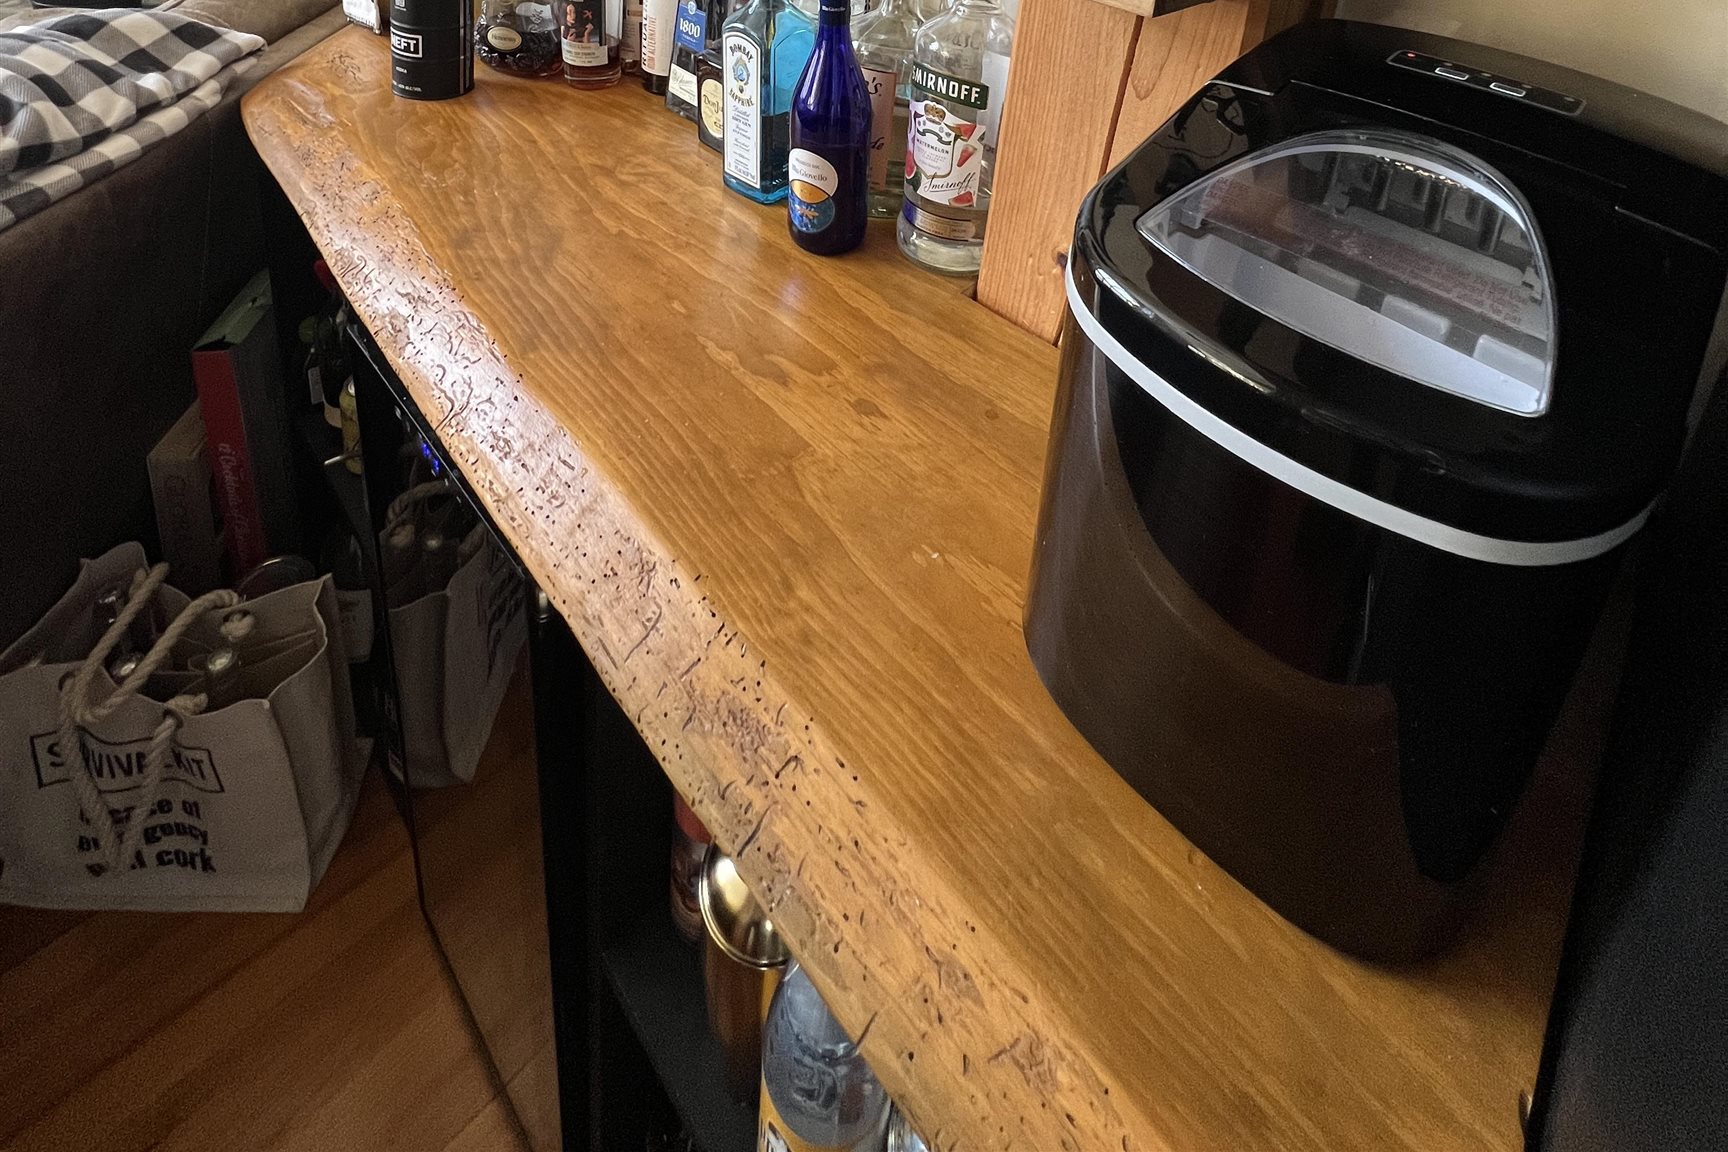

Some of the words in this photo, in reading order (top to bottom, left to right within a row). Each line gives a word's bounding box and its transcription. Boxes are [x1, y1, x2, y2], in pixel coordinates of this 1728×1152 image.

[679, 17, 701, 38] 1800
[729, 43, 754, 62] BOMBAY
[729, 88, 755, 107] SAPPHIRE
[916, 138, 950, 155] WATERMELON
[924, 171, 976, 195] Smirnoff
[156, 847, 217, 874] cork
